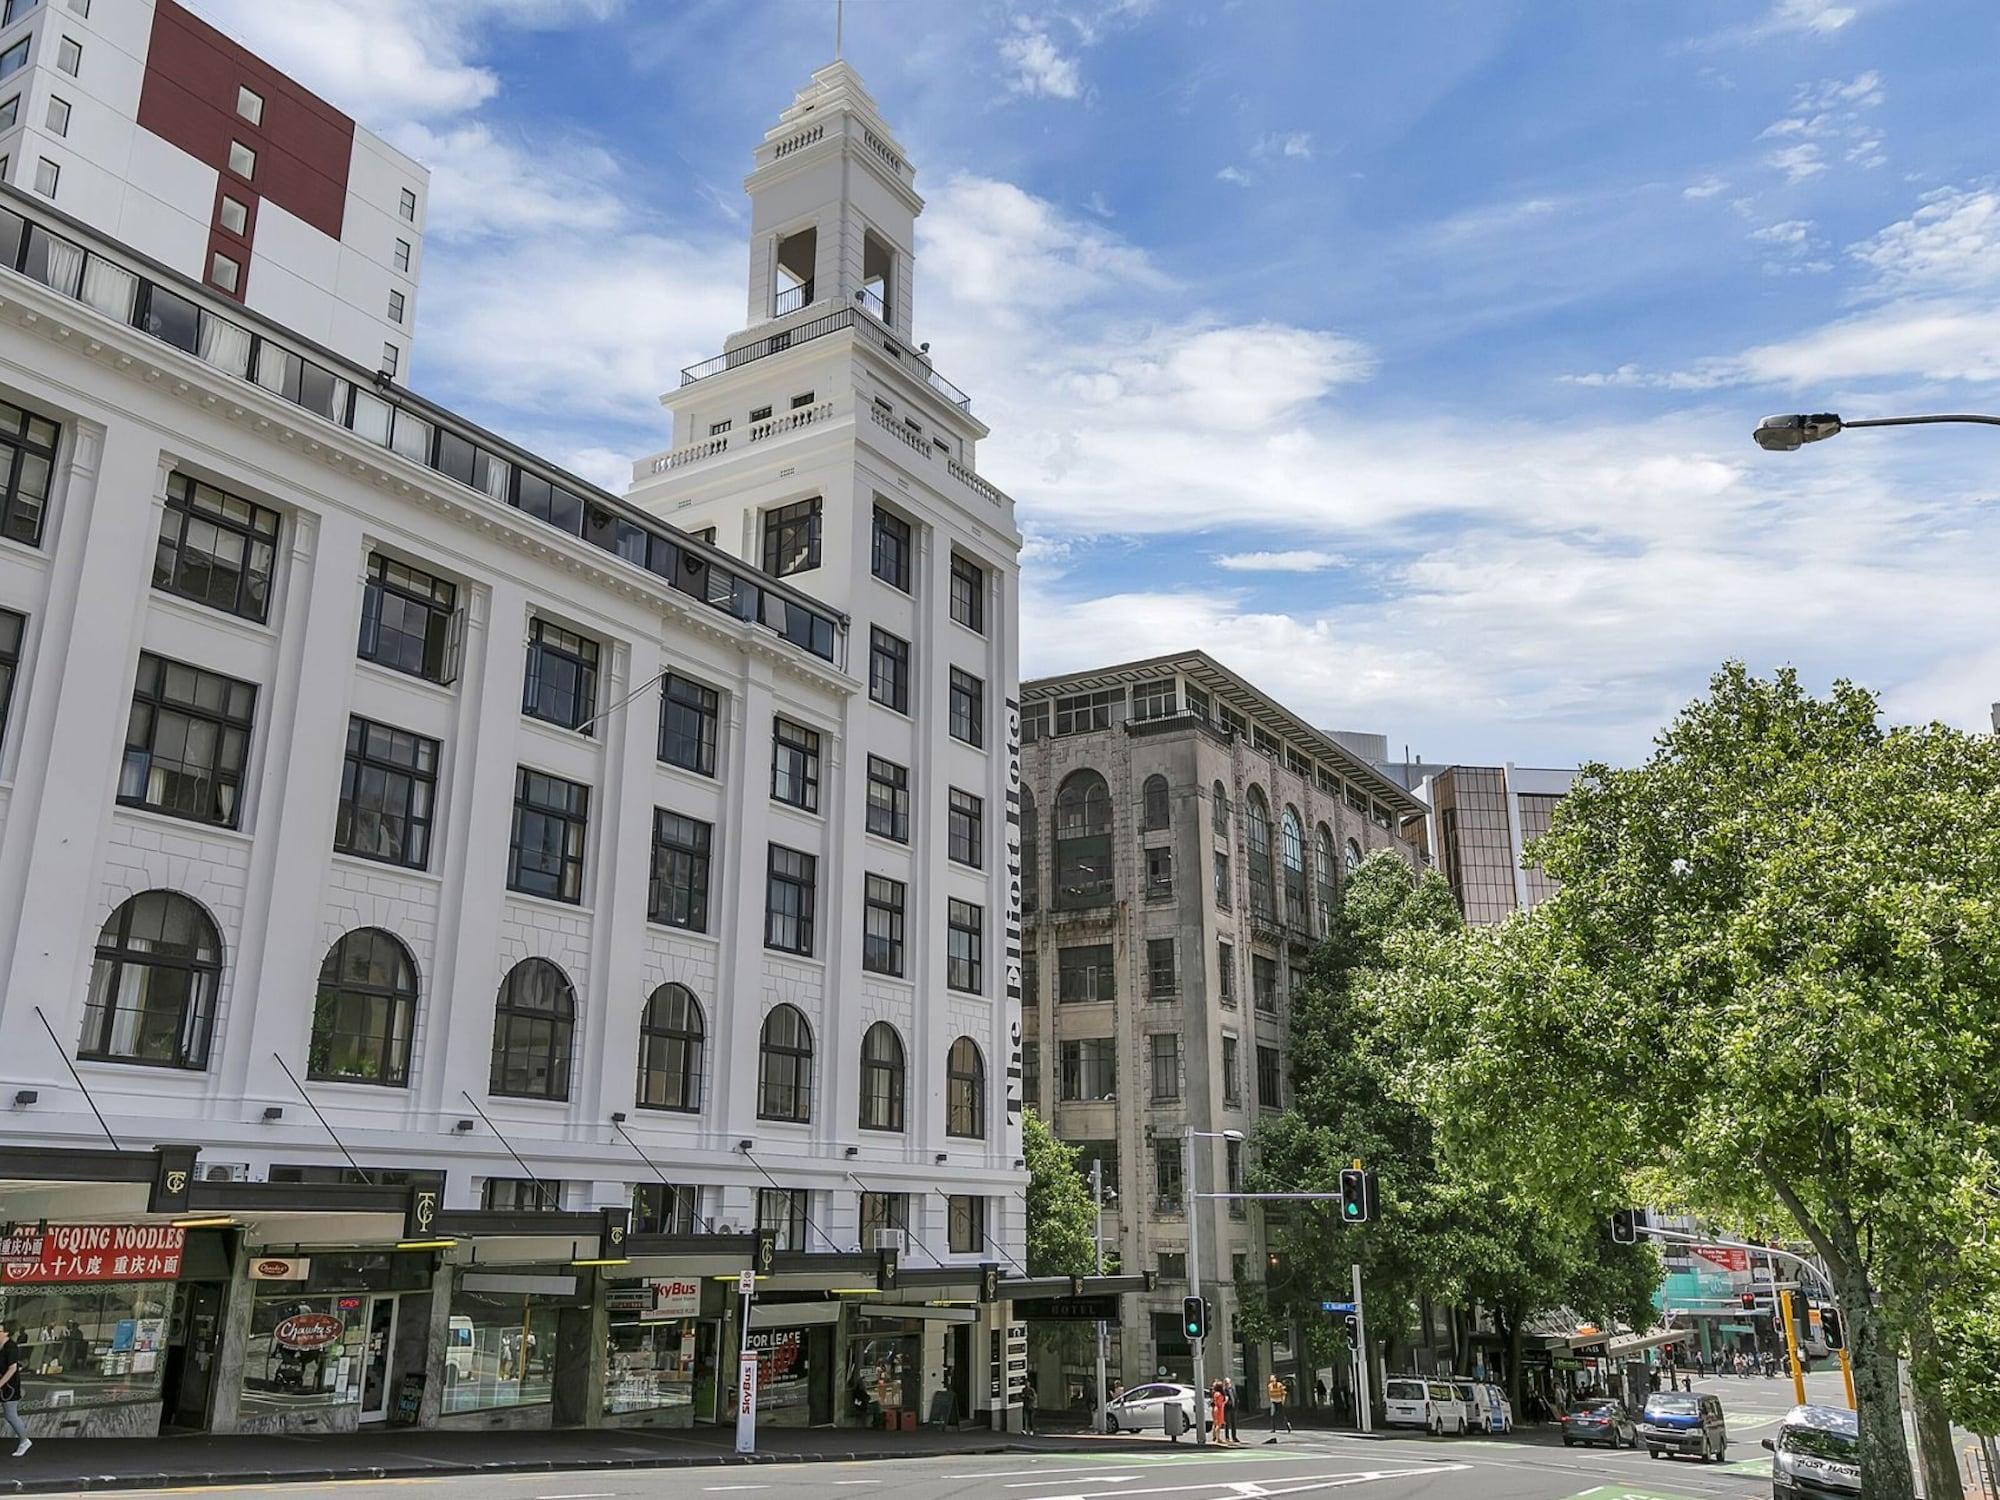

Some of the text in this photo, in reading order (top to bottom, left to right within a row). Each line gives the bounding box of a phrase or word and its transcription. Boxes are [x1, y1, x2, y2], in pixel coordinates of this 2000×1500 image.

[1006, 696, 1021, 1126] The Elliott Hotel
[0, 1237, 43, 1255] 重庆小面
[13, 1226, 185, 1254] NGQING NOODLES
[30, 1255, 180, 1276] 八十八度 重庆小面
[1051, 1304, 1096, 1315] HOTEL
[747, 1331, 800, 1348] FOR LEASE
[742, 1367, 752, 1414] SkyBus
[1797, 1460, 1861, 1477] POST HASTE
